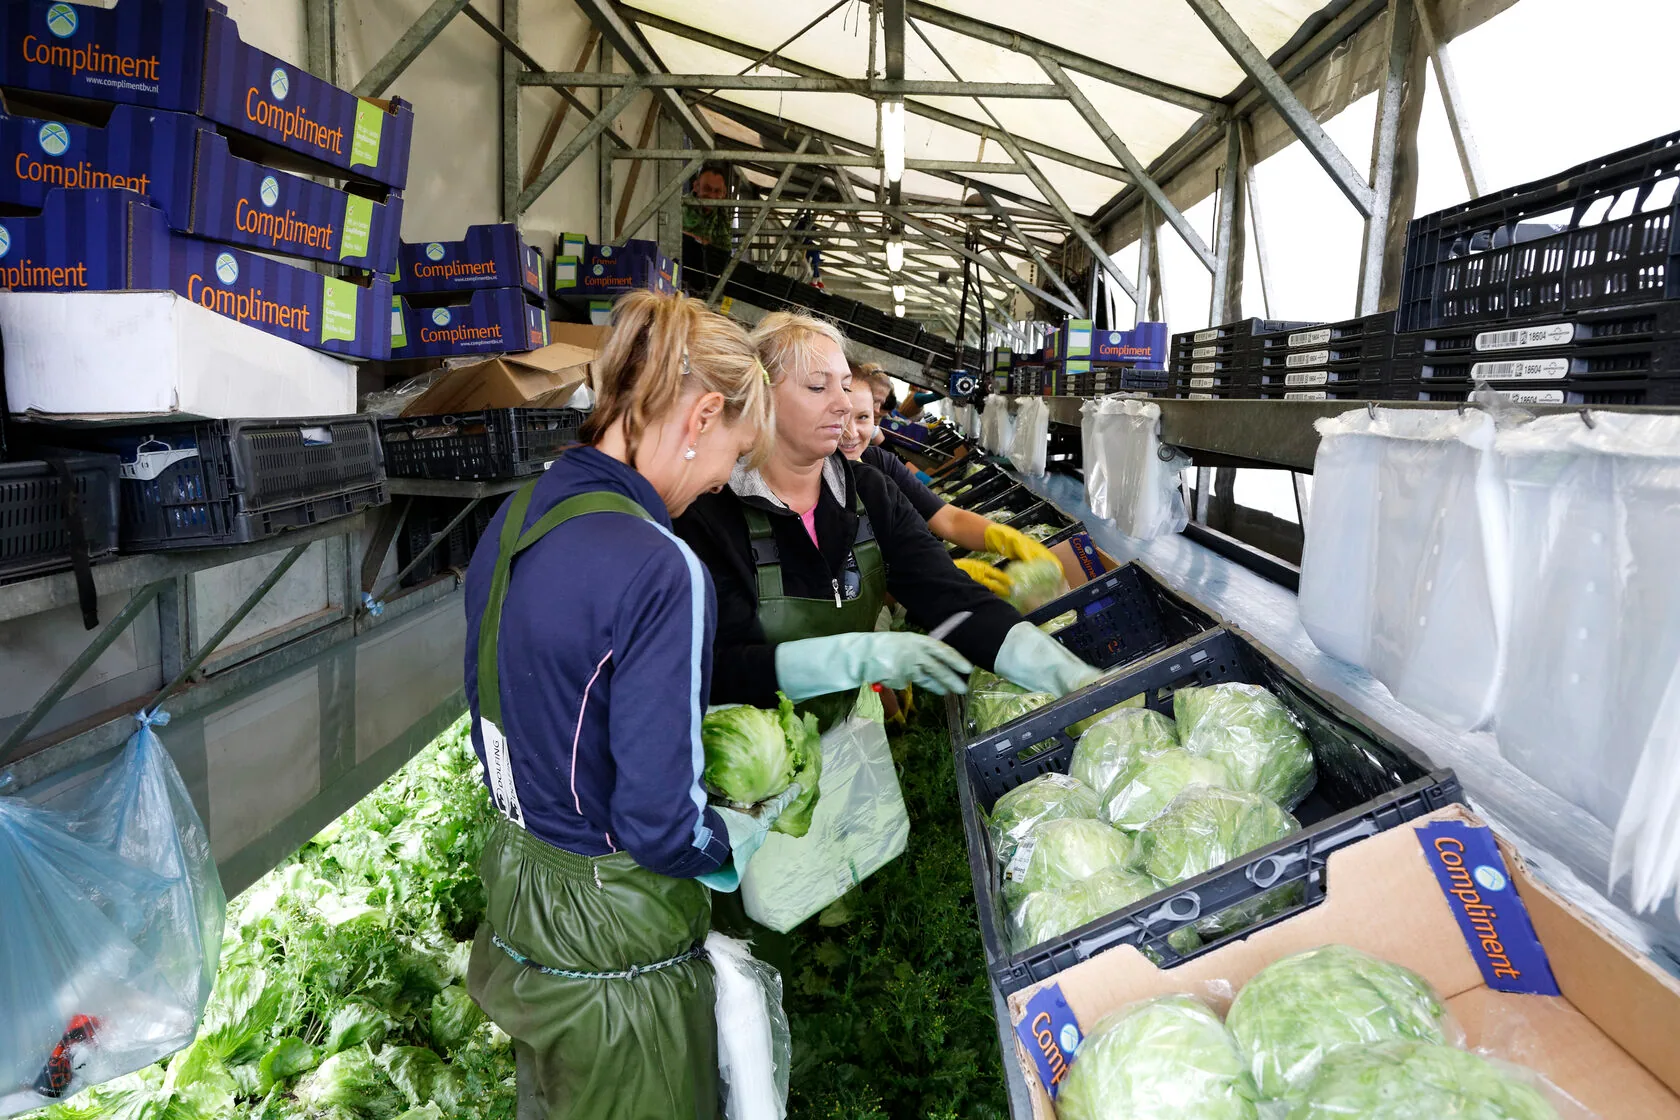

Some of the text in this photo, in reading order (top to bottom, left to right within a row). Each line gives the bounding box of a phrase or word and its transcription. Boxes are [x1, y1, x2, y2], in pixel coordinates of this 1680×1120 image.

[23, 35, 160, 81] Compliment
[86, 76, 159, 93] www.complimentbv.nl
[246, 87, 344, 155] Compliment
[15, 152, 151, 198] Compliment
[235, 198, 333, 251] Compliment
[414, 260, 497, 280] Compliment
[584, 275, 633, 287] Compliment
[187, 274, 310, 333] Compliment
[420, 324, 503, 345] Compliment
[1099, 344, 1152, 357] Compliment
[493, 739, 504, 790] DOLFING
[1434, 837, 1521, 980] Compliment
